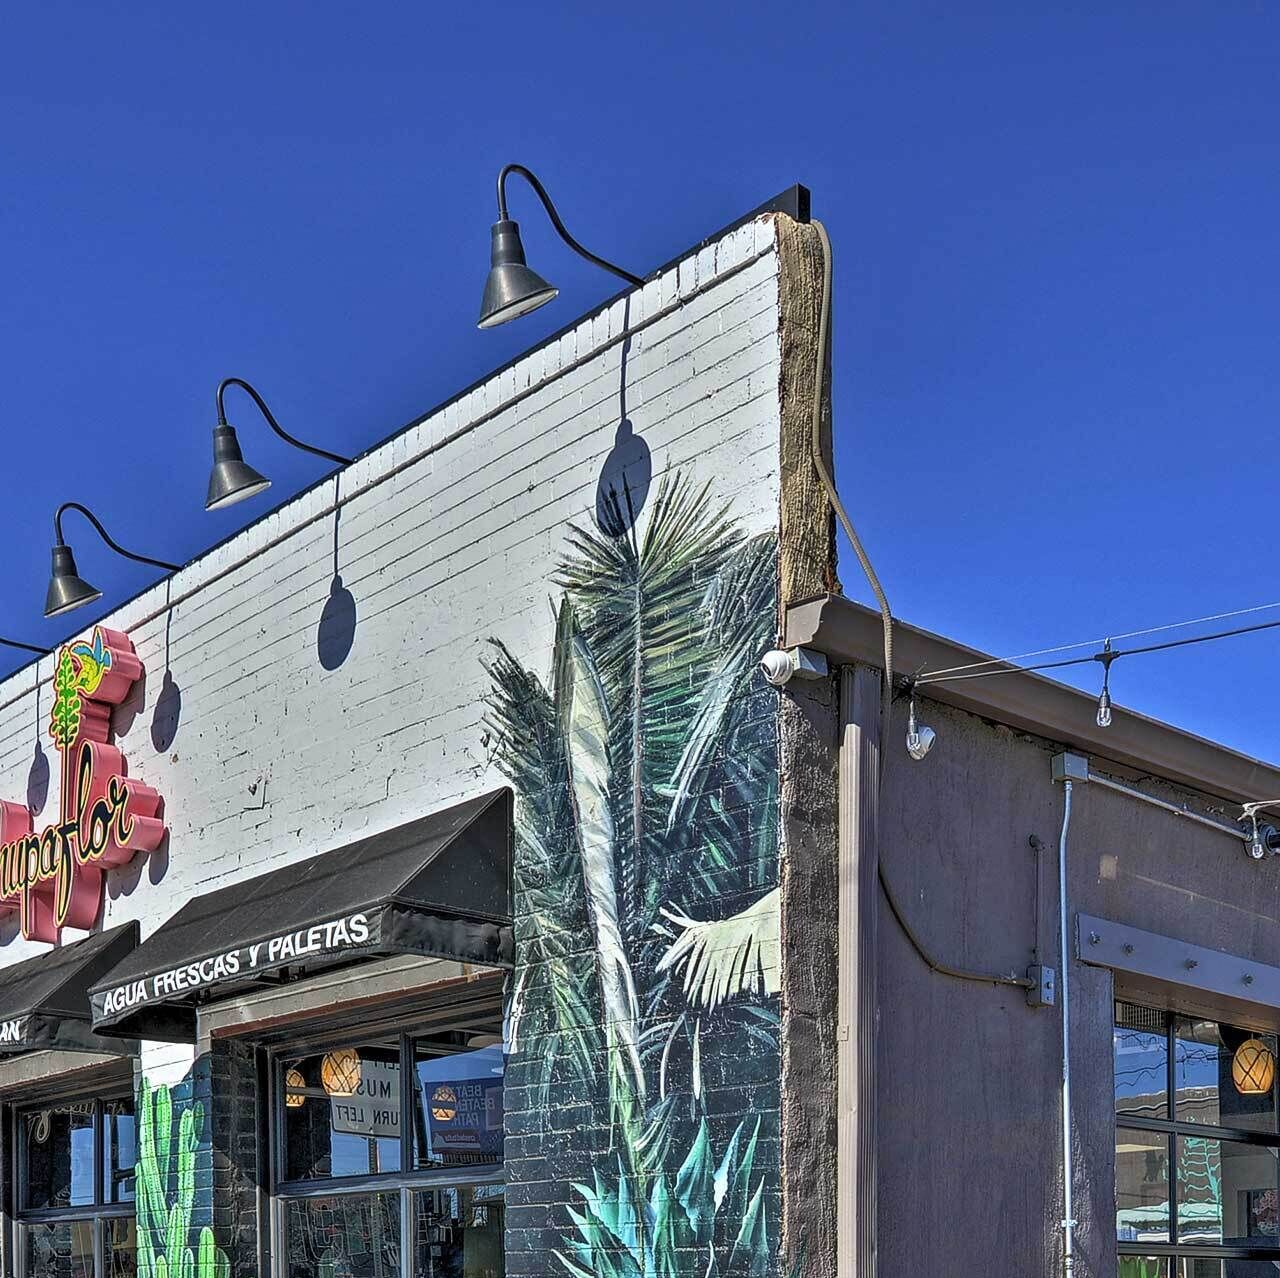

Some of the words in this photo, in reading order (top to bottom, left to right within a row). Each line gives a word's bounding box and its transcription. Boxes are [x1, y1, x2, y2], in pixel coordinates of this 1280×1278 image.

[103, 979, 148, 1016] AGUA
[153, 951, 240, 997] FRESCAS
[248, 945, 264, 968] Y
[268, 913, 369, 962] PALETAS
